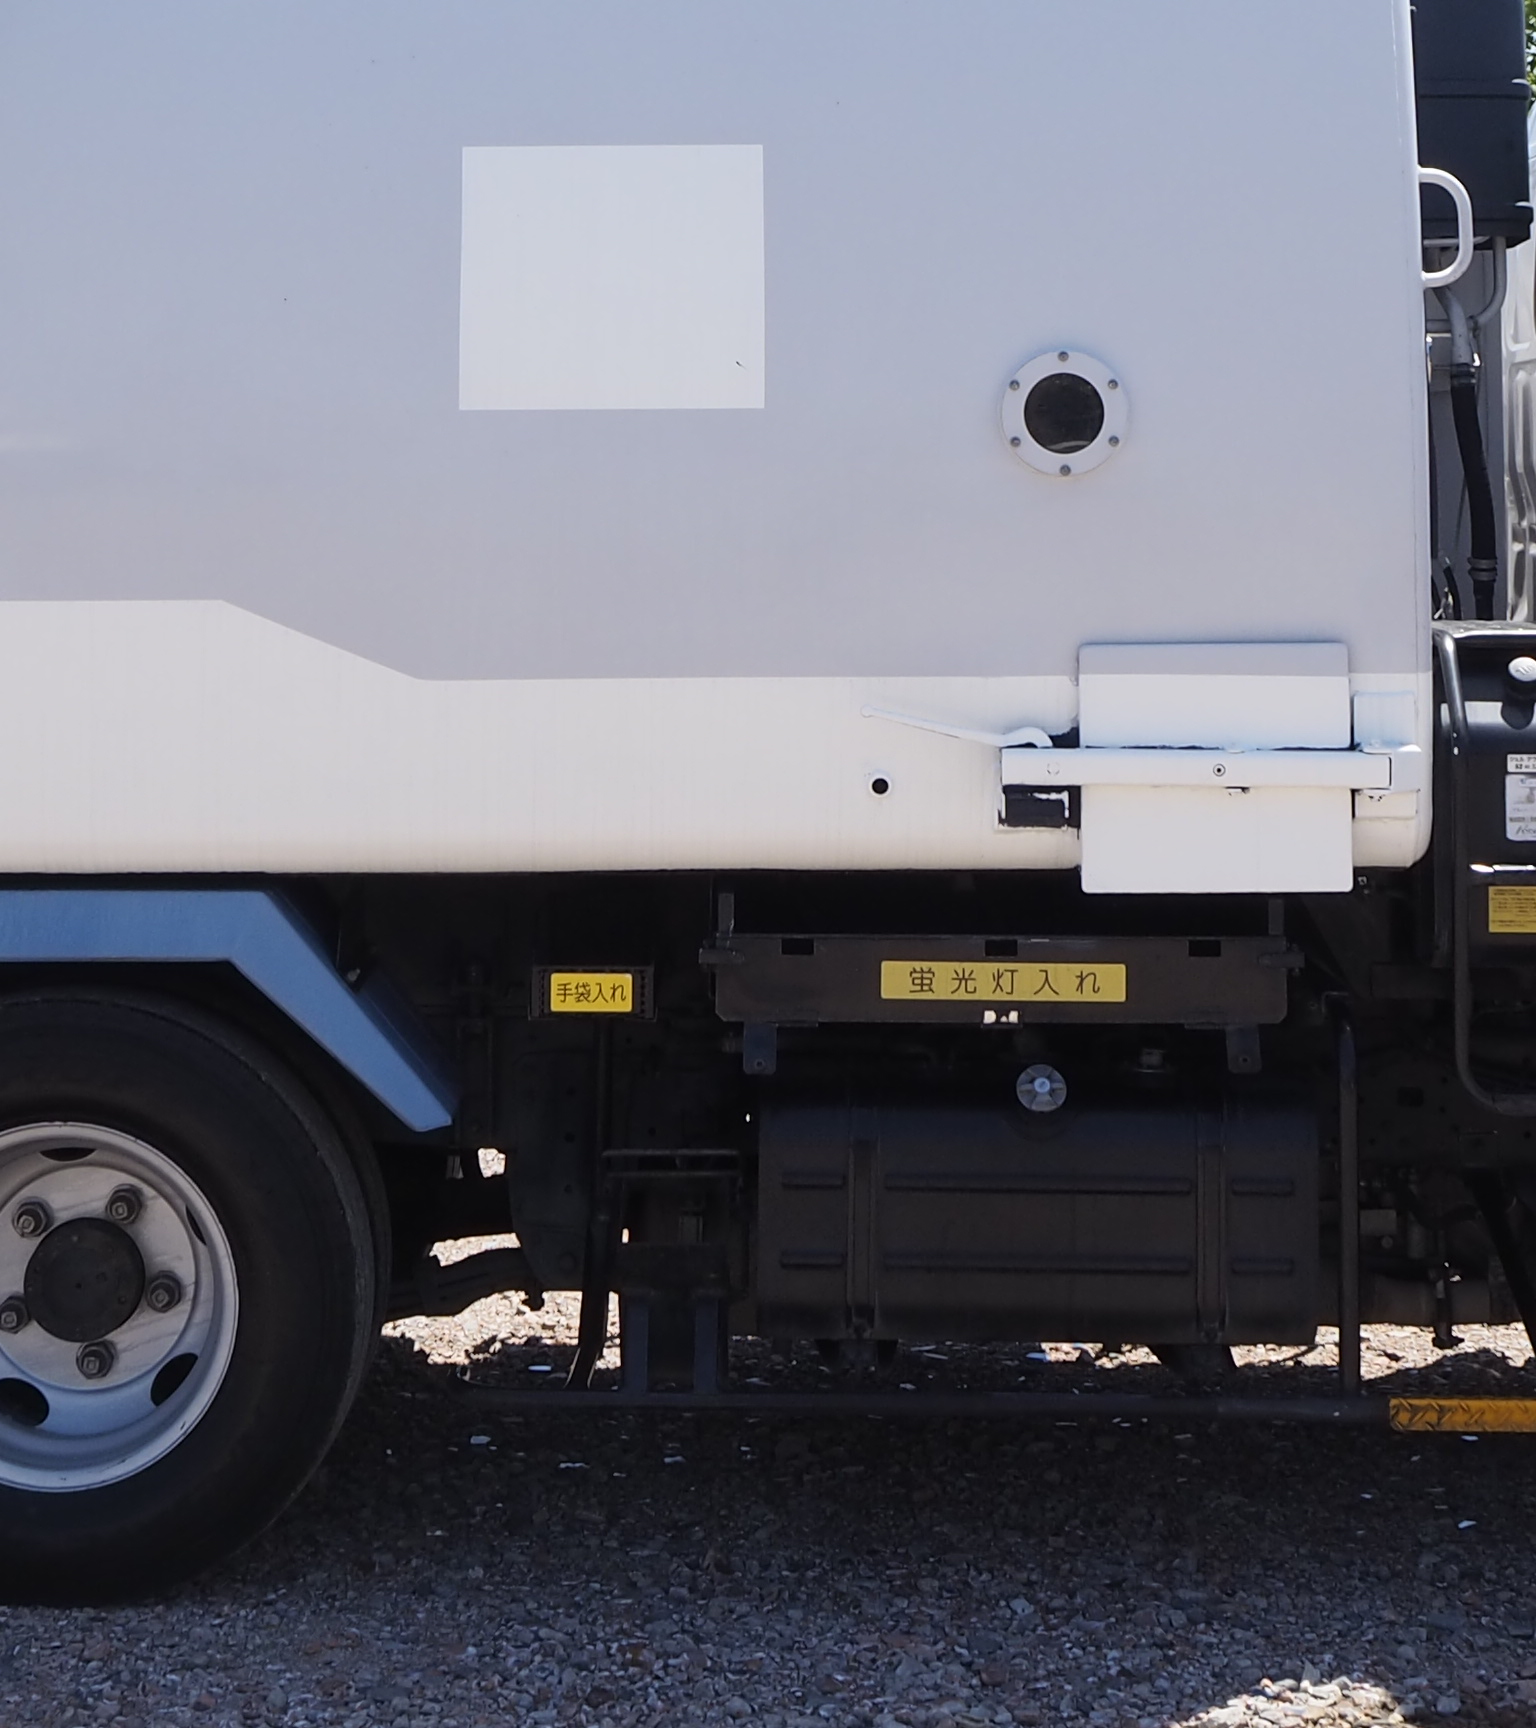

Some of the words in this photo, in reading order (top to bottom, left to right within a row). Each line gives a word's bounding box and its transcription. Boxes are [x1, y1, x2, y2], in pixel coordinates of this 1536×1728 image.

[556, 981, 627, 1004] 手袋入れ
[908, 967, 1101, 996] 蛍光灯入れ
